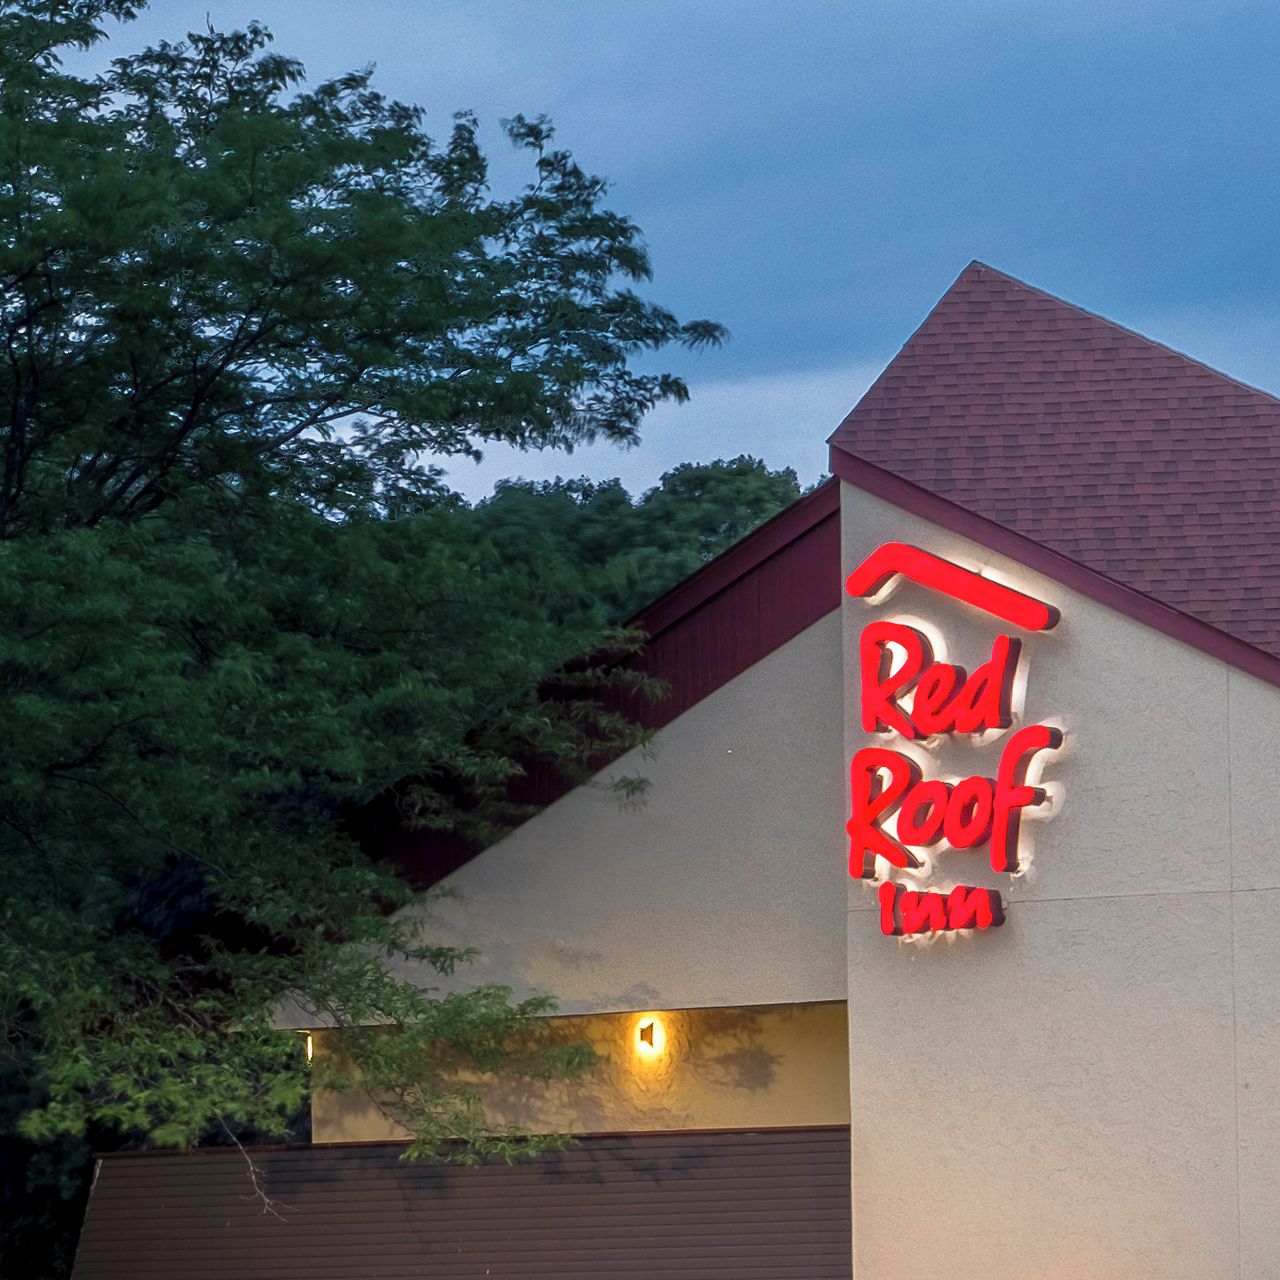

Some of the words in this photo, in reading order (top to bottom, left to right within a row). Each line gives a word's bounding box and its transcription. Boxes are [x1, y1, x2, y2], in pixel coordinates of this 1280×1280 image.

[860, 621, 1018, 738] Red
[846, 725, 1060, 878] Roof
[878, 881, 1004, 935] Inn
